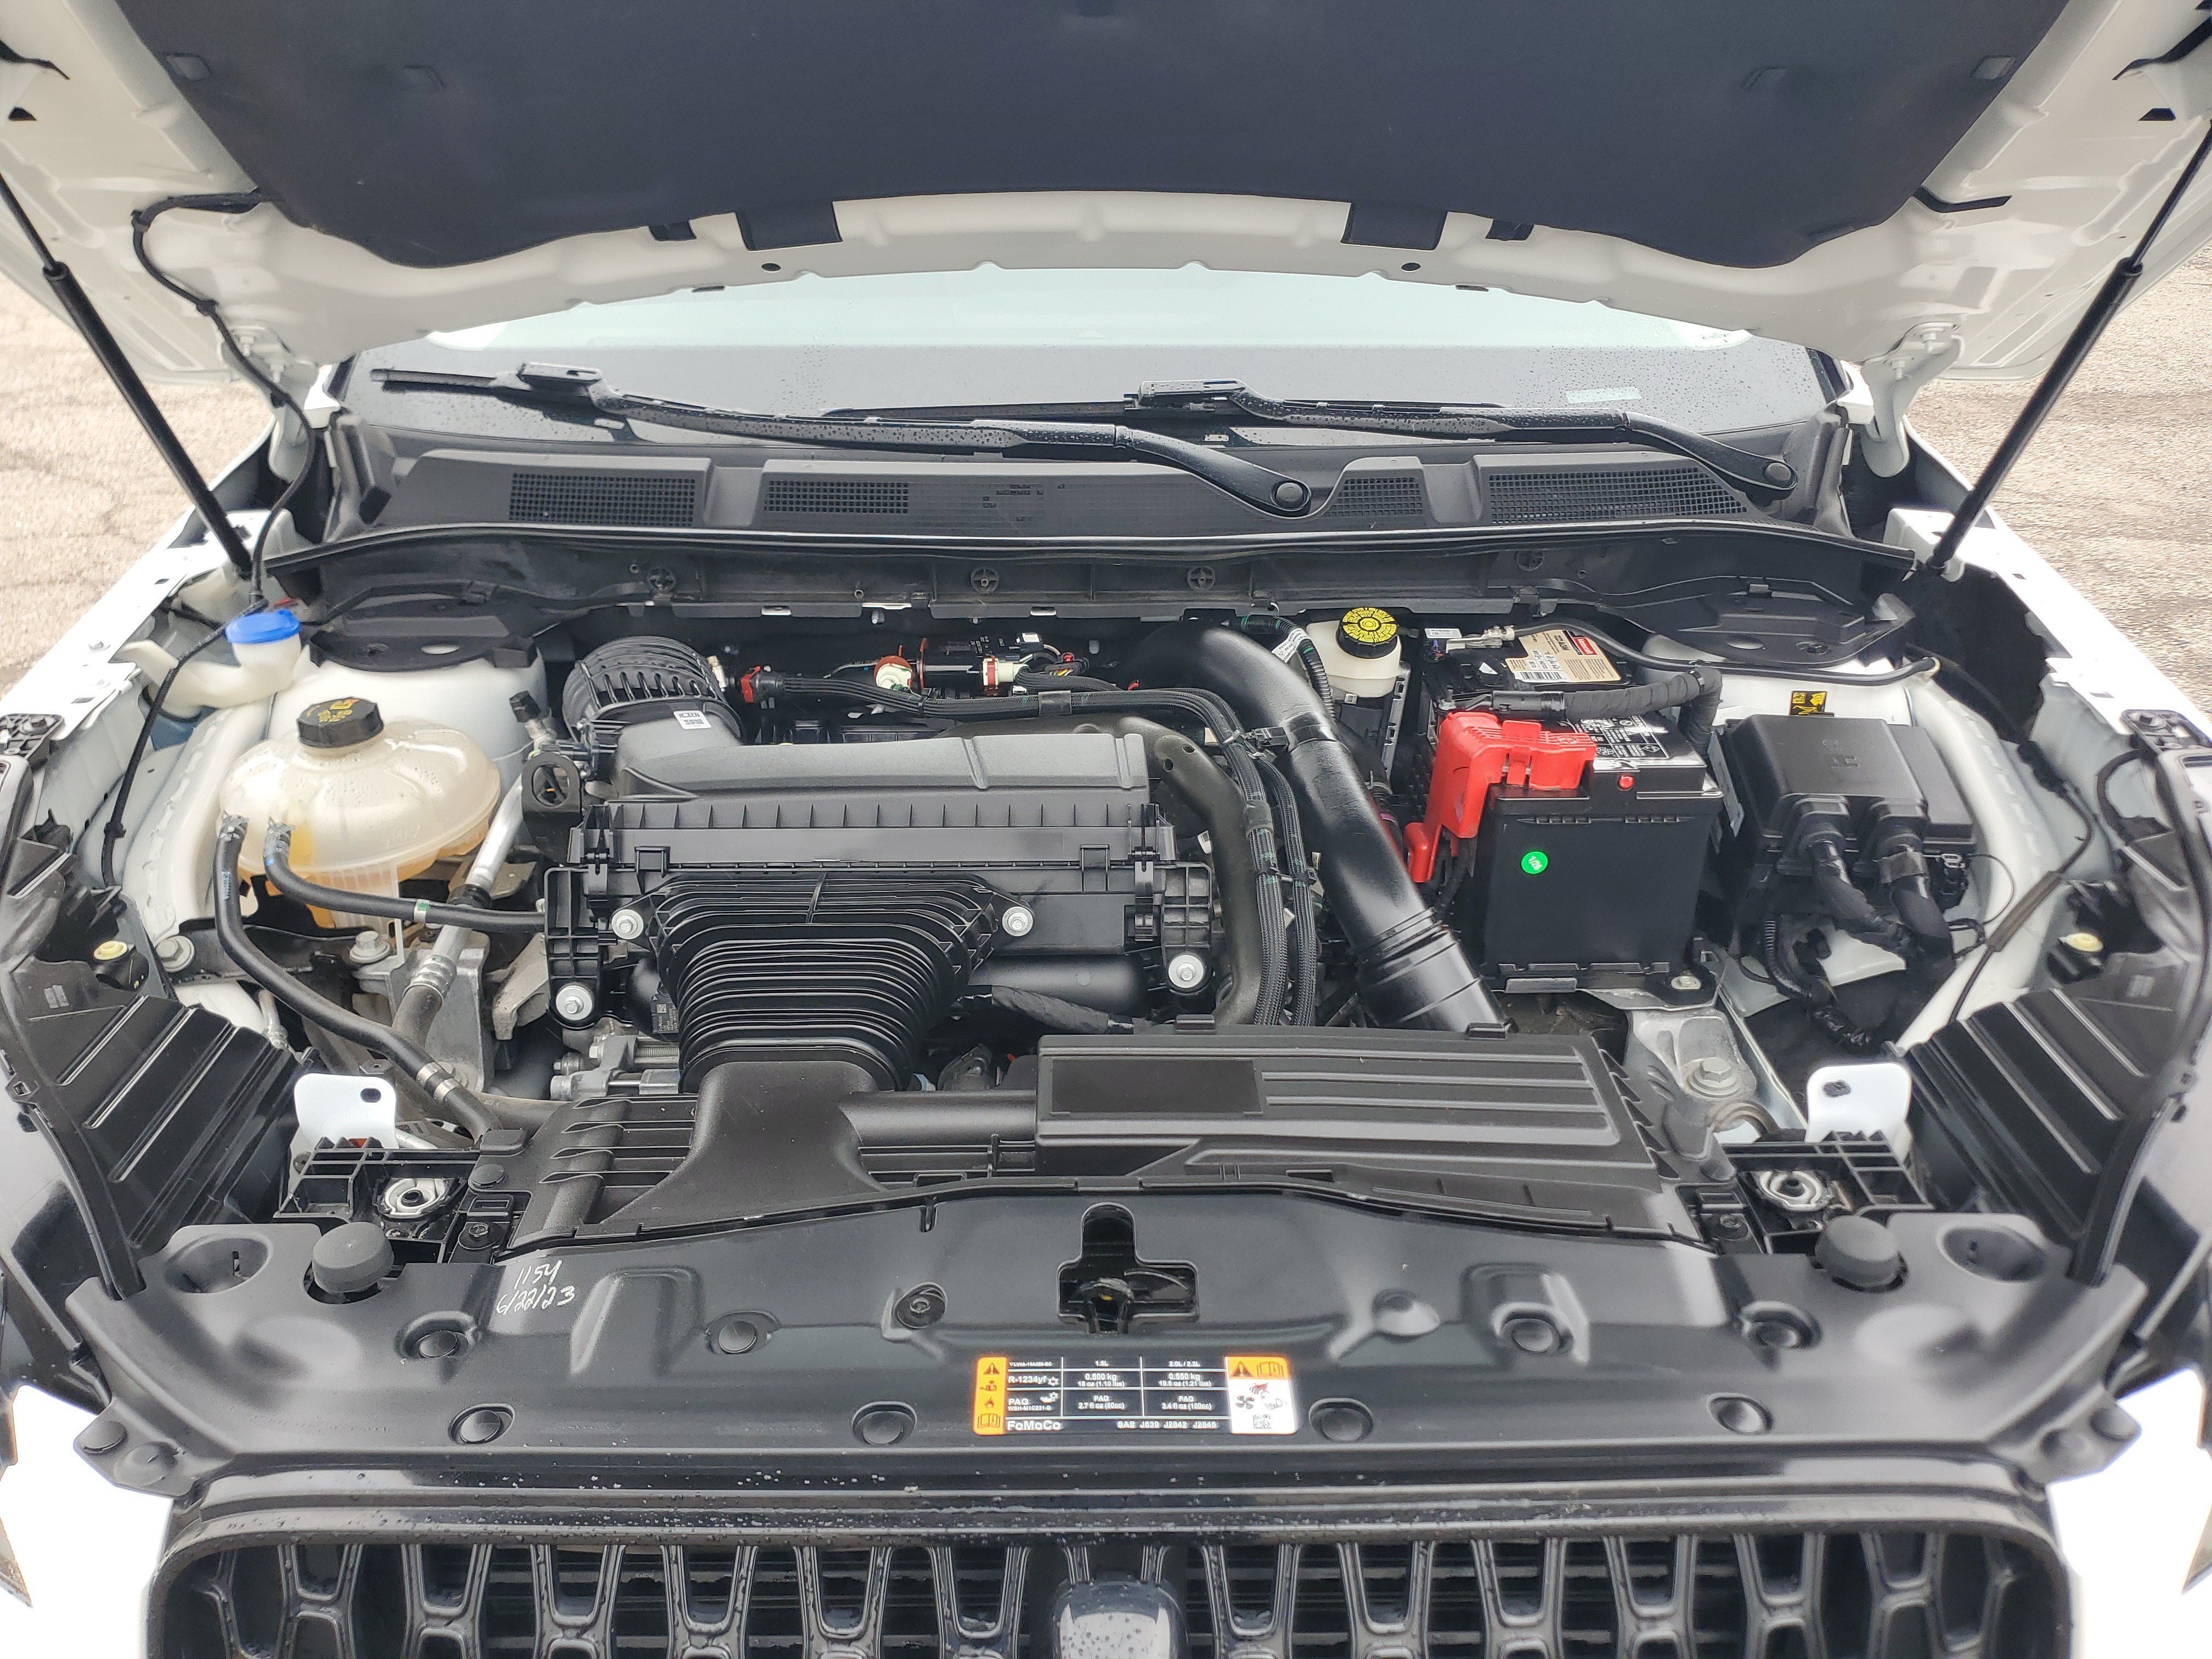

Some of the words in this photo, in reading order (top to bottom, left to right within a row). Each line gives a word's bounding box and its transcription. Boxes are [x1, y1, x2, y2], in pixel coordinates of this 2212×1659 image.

[514, 1260, 562, 1290] 1154
[1008, 1375, 1047, 1384] R-1234yf
[1107, 1373, 1117, 1381] kg
[1190, 1373, 1200, 1381] kg
[1007, 1420, 1061, 1430] FoMoCo
